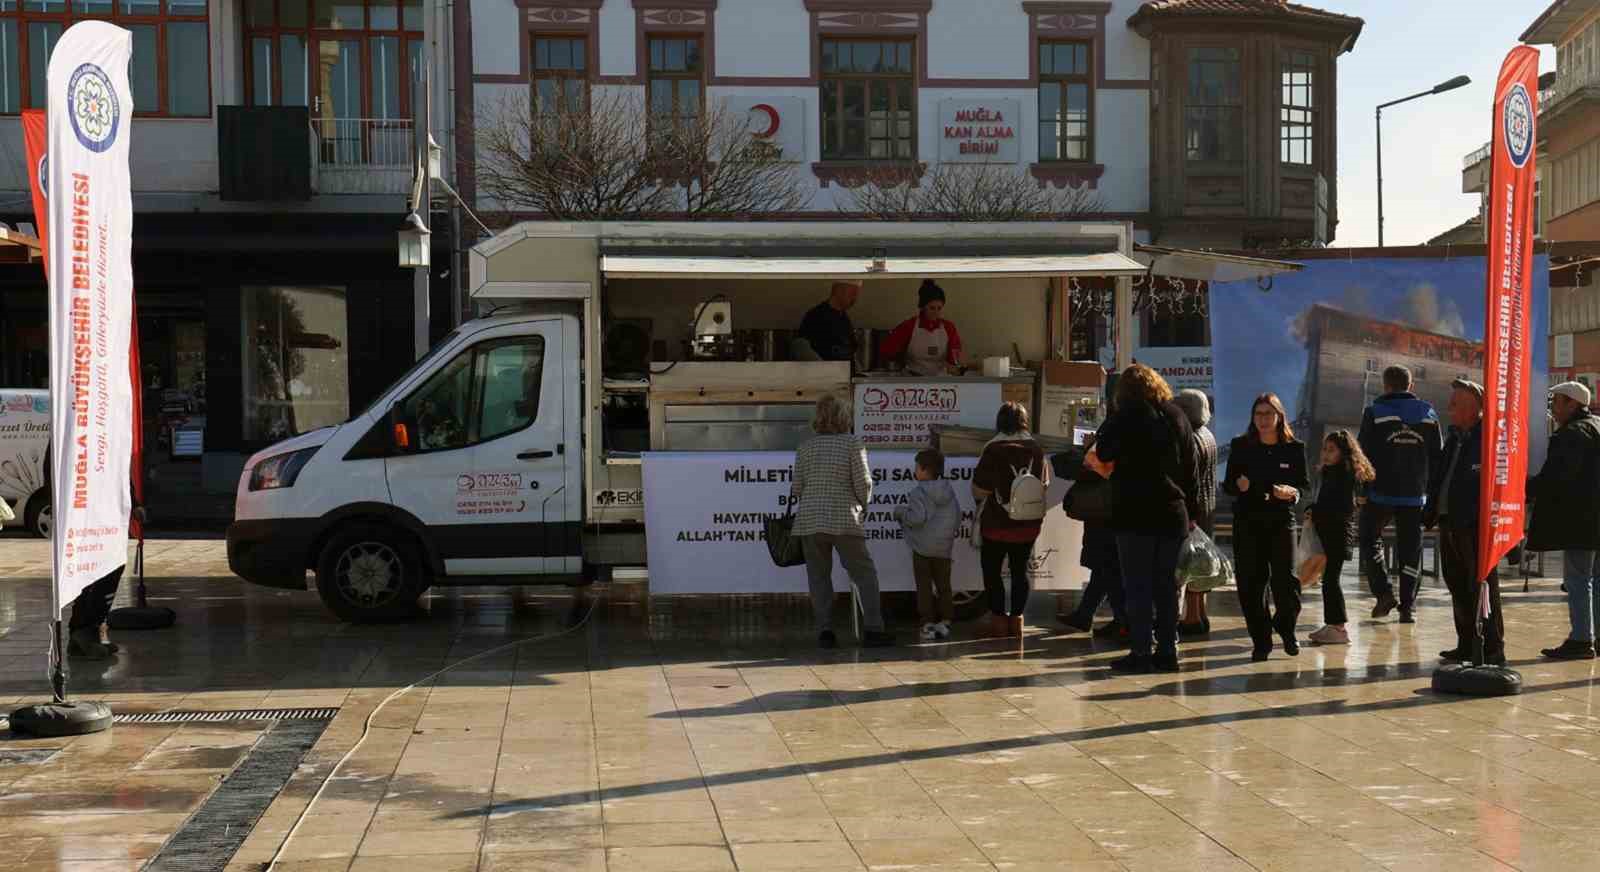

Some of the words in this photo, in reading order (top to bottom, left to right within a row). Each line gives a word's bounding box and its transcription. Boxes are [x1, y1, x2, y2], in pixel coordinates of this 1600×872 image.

[955, 107, 1003, 122] MUĞLA
[944, 127, 972, 138] KAN
[976, 127, 1014, 138] ALMA
[960, 140, 999, 154] BİRİMİ
[71, 173, 90, 289] BELEDİYESİ
[70, 297, 91, 427] BÜYÜKŞEHİR
[74, 434, 88, 509] MUĞLA
[725, 465, 793, 482] MİLLETİ
[871, 468, 887, 485] ŞI
[892, 468, 917, 481] SA
[676, 531, 755, 542] ALLAH'TAN
[864, 526, 904, 540] ERİNE
